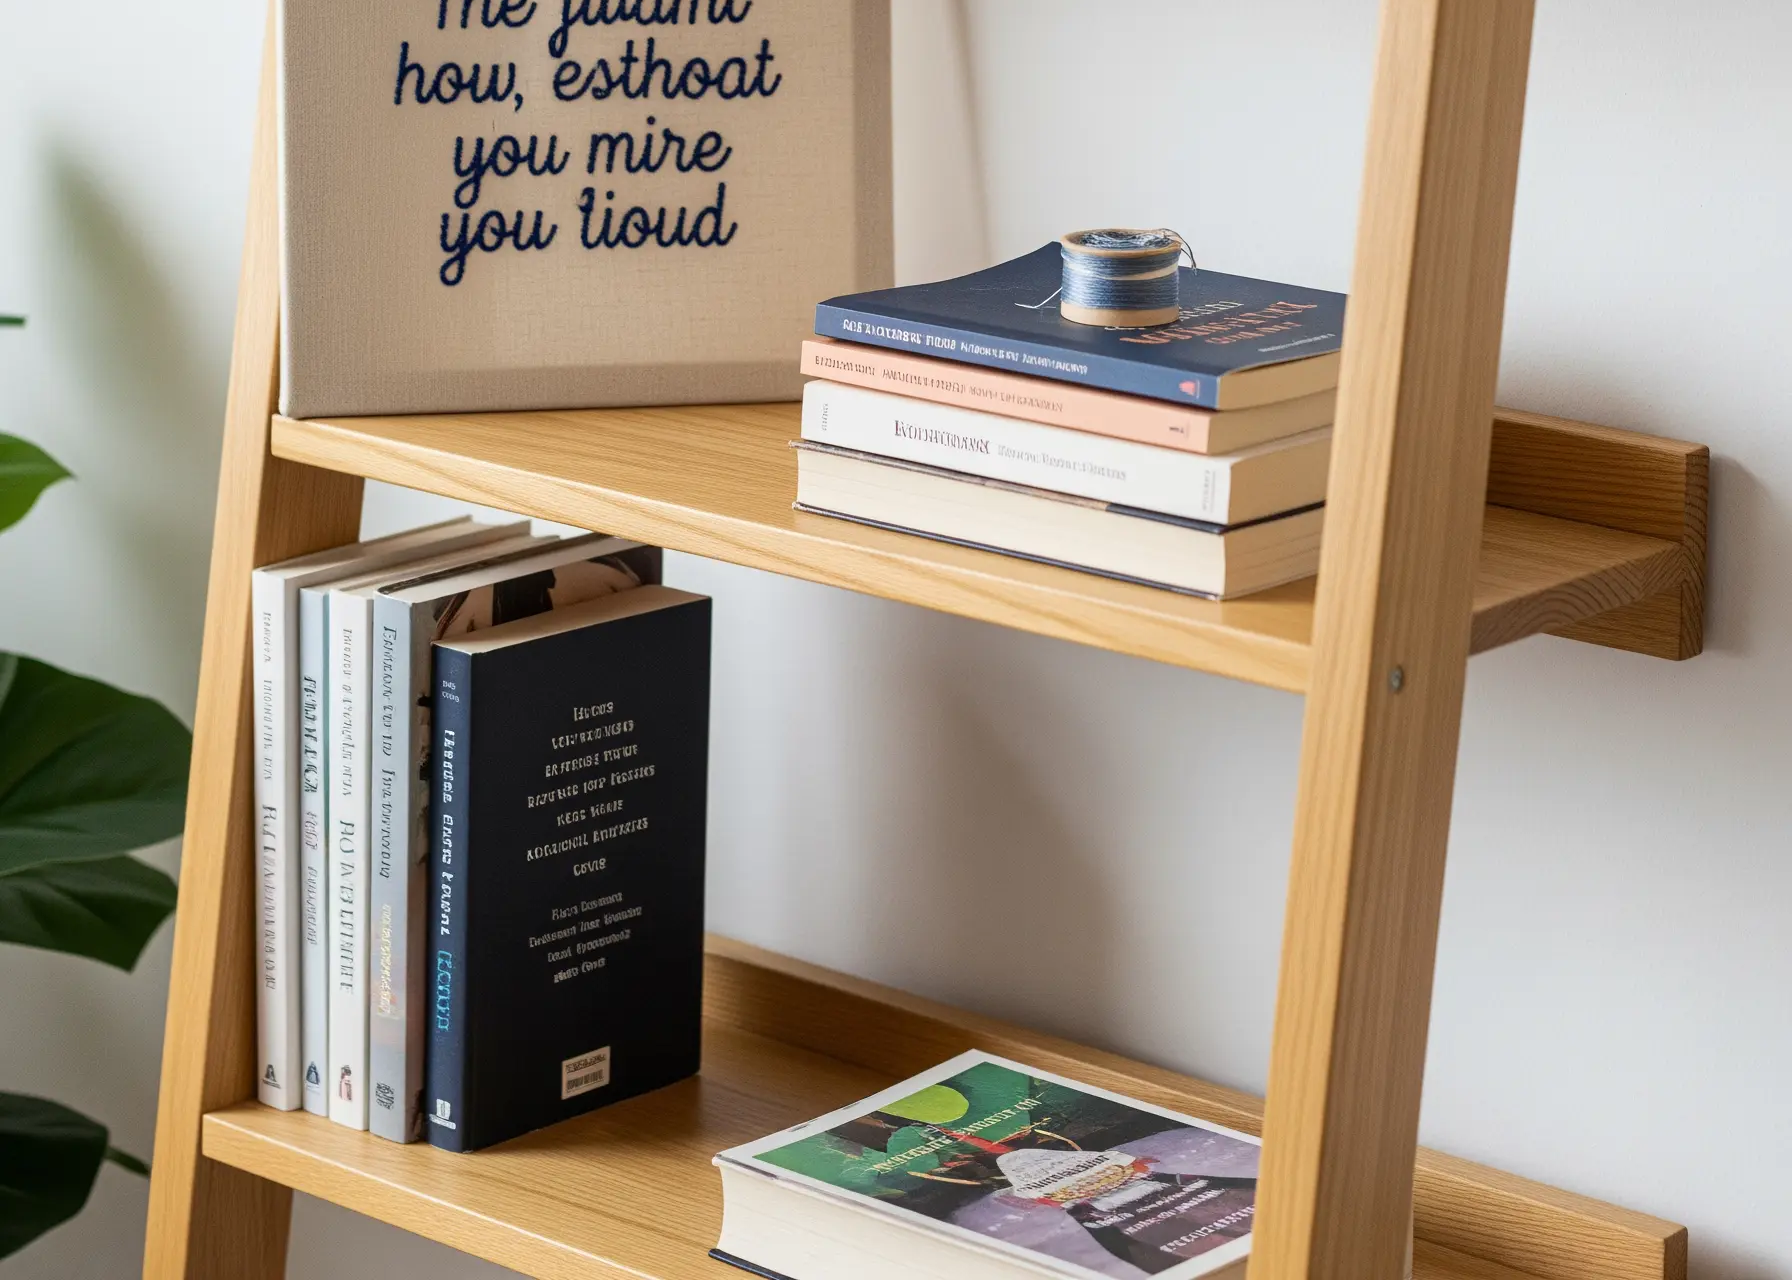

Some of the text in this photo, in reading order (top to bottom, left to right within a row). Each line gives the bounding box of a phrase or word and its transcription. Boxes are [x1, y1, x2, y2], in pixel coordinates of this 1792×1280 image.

[393, 36, 783, 113] how, esthoat
[453, 115, 733, 210] you mire
[439, 209, 558, 287] you
